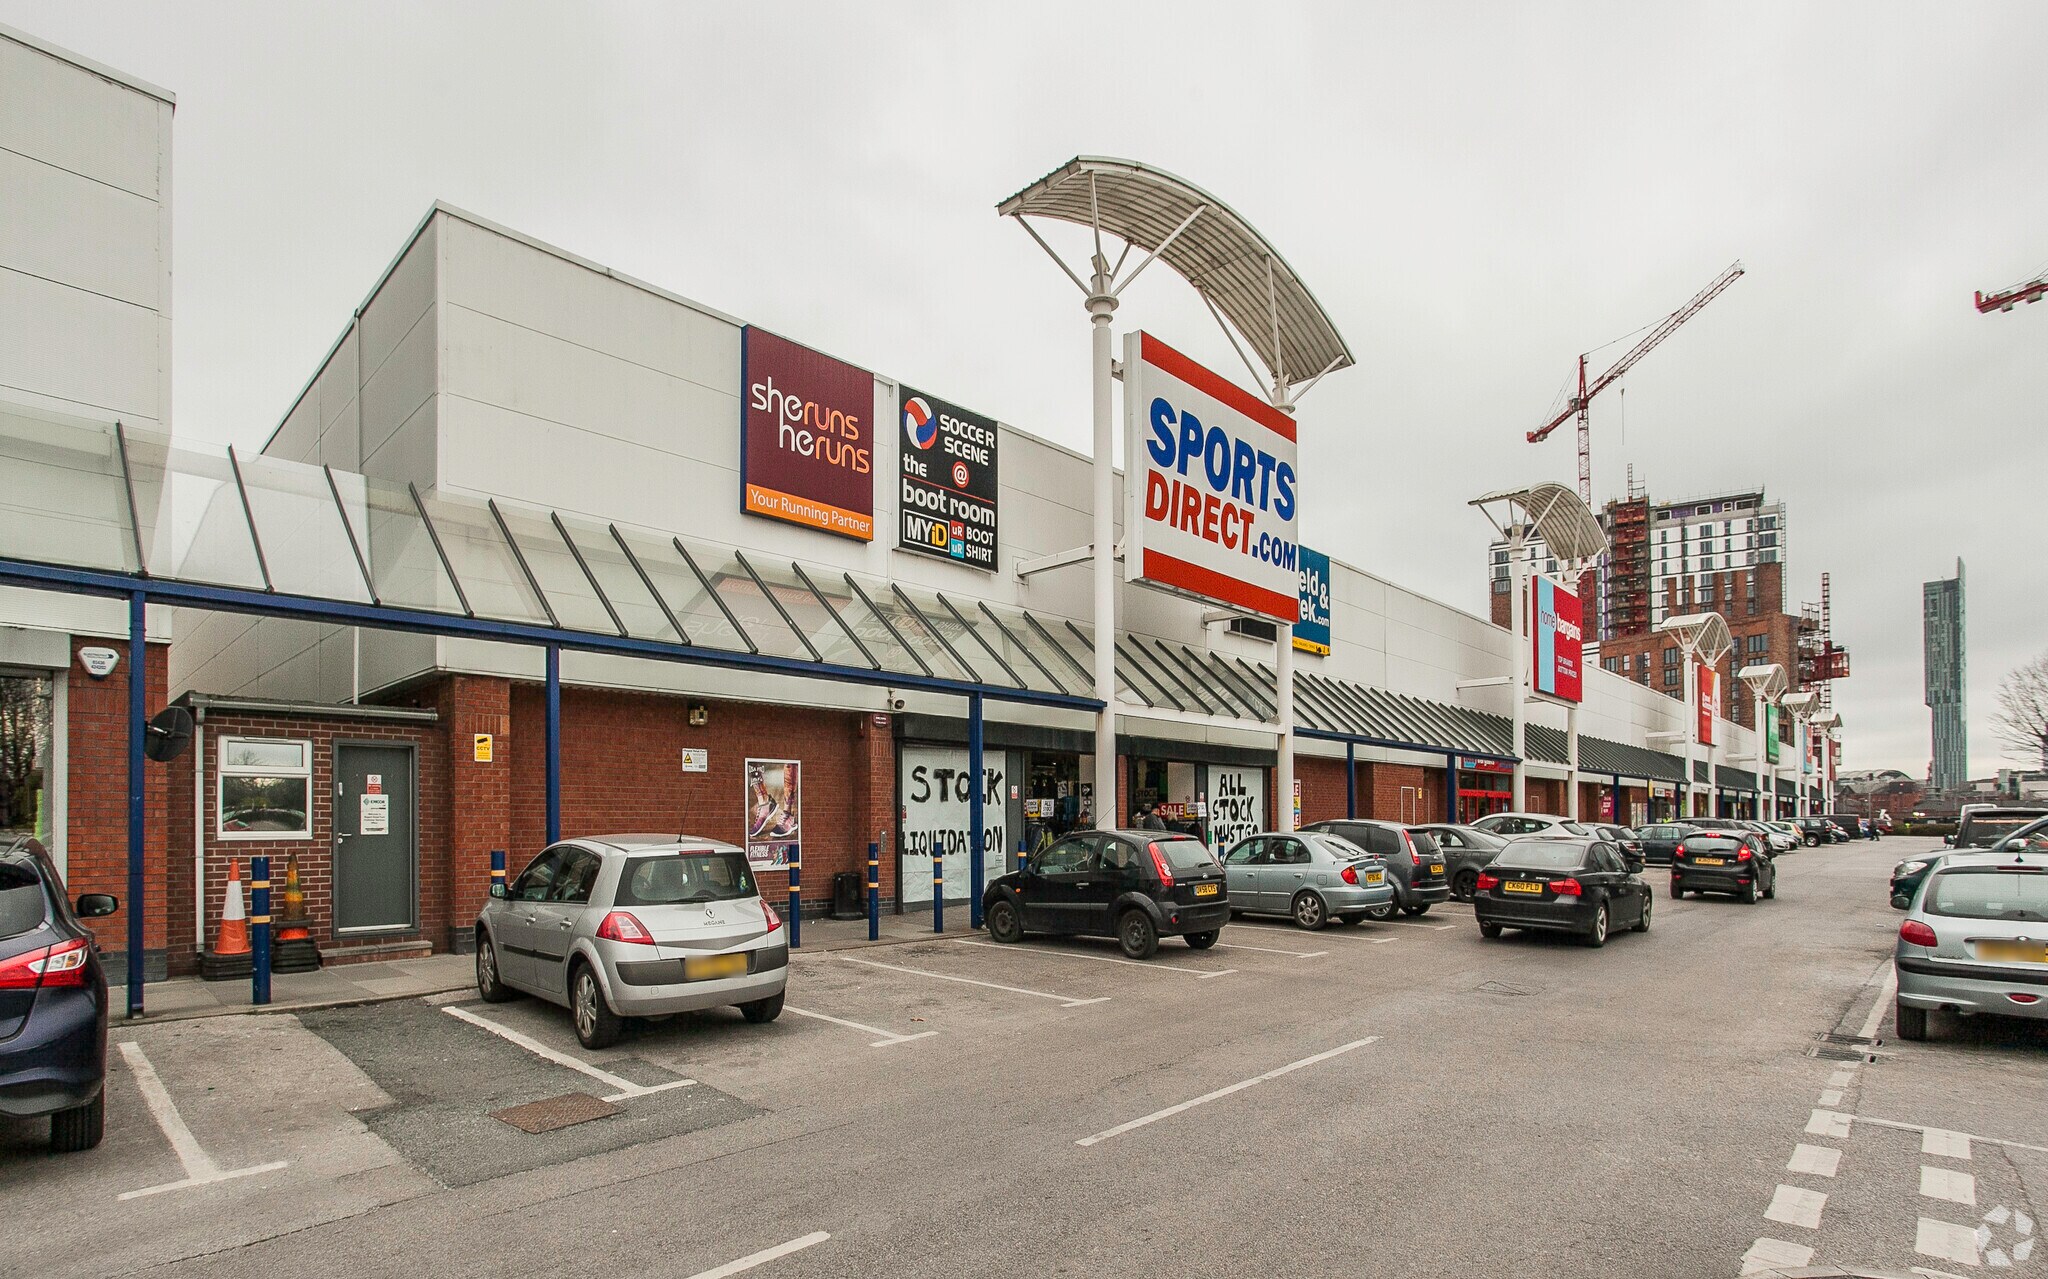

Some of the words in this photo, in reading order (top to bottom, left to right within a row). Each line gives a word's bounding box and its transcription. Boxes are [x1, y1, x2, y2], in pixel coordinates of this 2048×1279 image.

[939, 413, 995, 449] SOCCER
[903, 453, 928, 478] the
[944, 436, 989, 467] SCENE
[1146, 397, 1296, 522] SPORTS
[954, 465, 969, 485] @
[751, 489, 779, 509] Your
[781, 497, 829, 525] Running
[831, 510, 871, 533] Partner
[902, 478, 947, 514] boot
[950, 498, 995, 528] room
[907, 515, 948, 548] MYiD
[951, 524, 964, 537] uR
[966, 526, 994, 546] BOOT
[1145, 468, 1297, 573] DIRECT.COM
[951, 543, 964, 556] uR
[965, 547, 993, 563] SHIRT
[1299, 567, 1319, 597] eld
[1319, 583, 1329, 610] &
[1540, 606, 1556, 629] home
[1556, 612, 1581, 641] bargains
[911, 765, 1003, 806] STOK
[1219, 773, 1247, 797] ALL
[1161, 805, 1184, 816] SALE
[1212, 796, 1255, 822] STOCK
[900, 825, 1003, 858] LIQUIDAON
[1525, 883, 1540, 891] FLD
